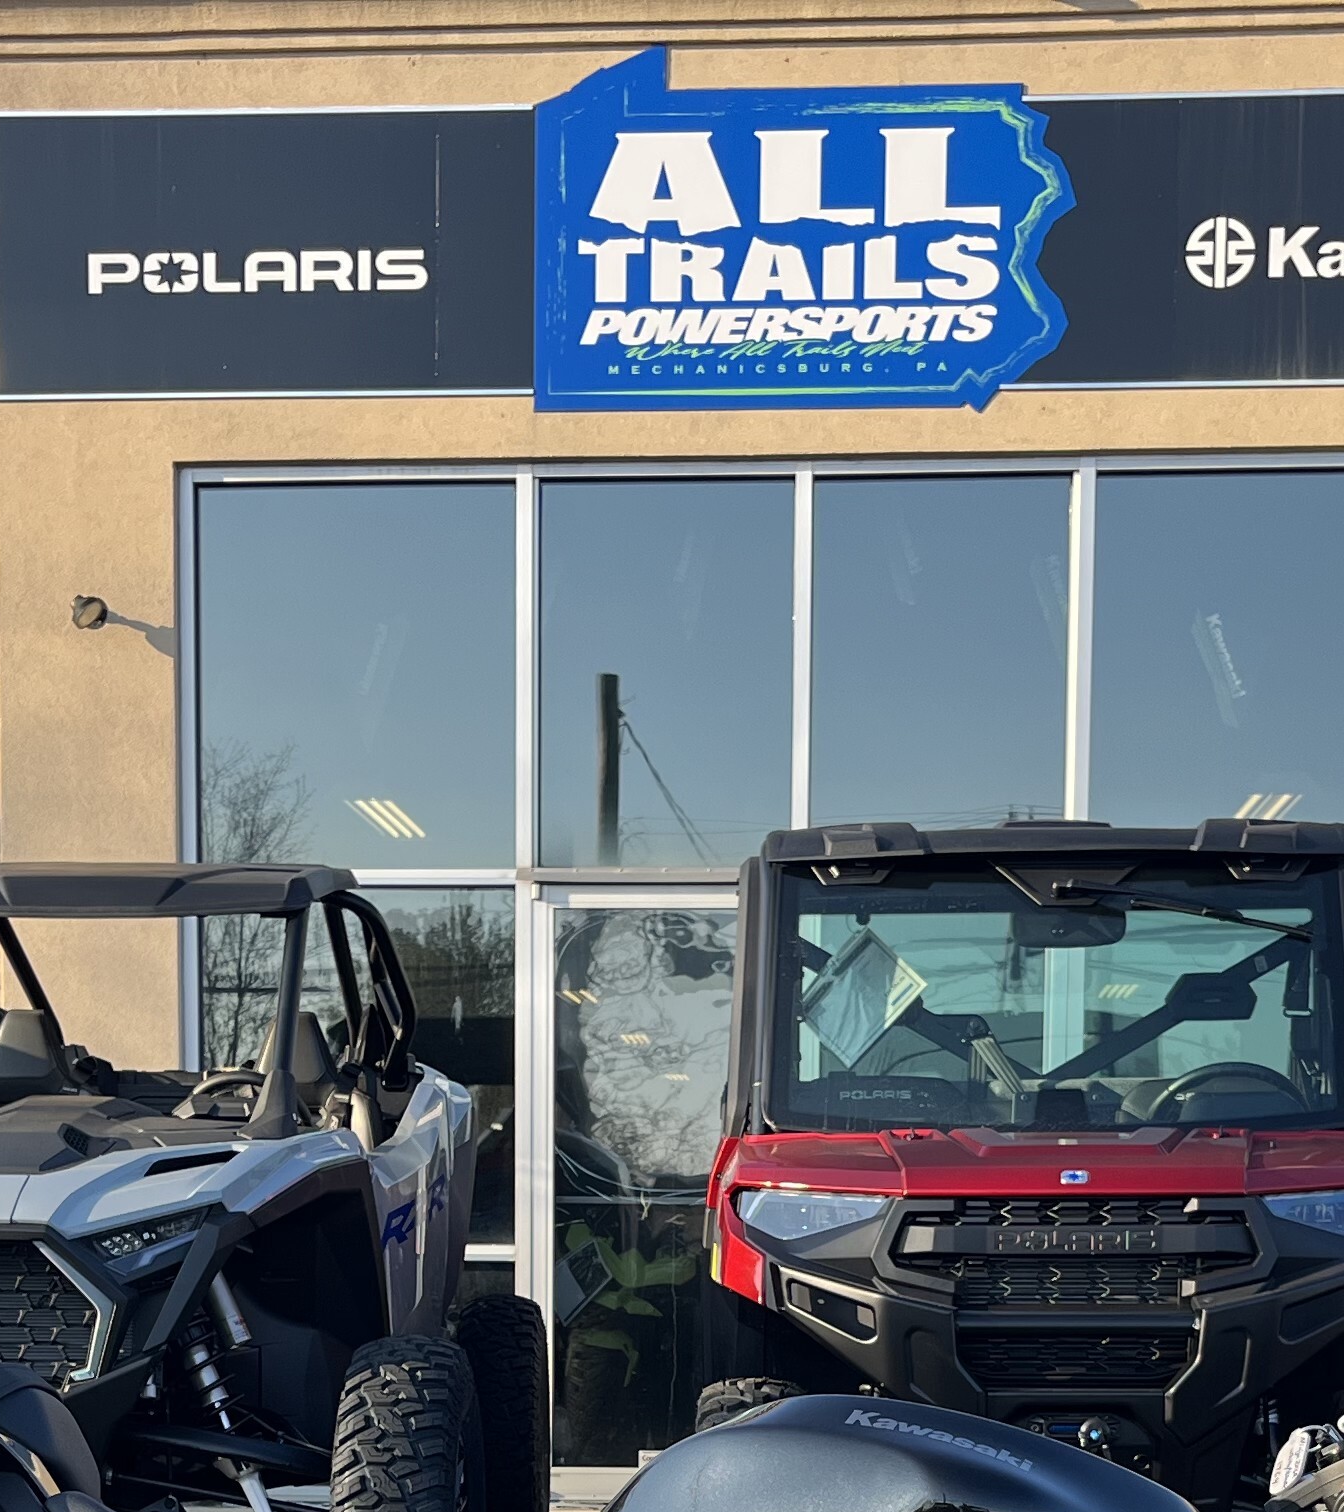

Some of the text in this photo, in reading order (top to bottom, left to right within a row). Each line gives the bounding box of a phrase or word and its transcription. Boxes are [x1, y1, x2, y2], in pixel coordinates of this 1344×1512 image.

[588, 126, 1002, 236] ALL
[86, 248, 430, 296] POLARIS
[578, 233, 1000, 303] TRAILS
[579, 304, 998, 347] POWERSPORTS
[623, 338, 928, 361] Where All Trails Meet
[916, 361, 948, 373] PA
[839, 1089, 912, 1101] POLARIS
[993, 1229, 1156, 1252] POLARIS
[844, 1408, 1034, 1473] Kawasaki
